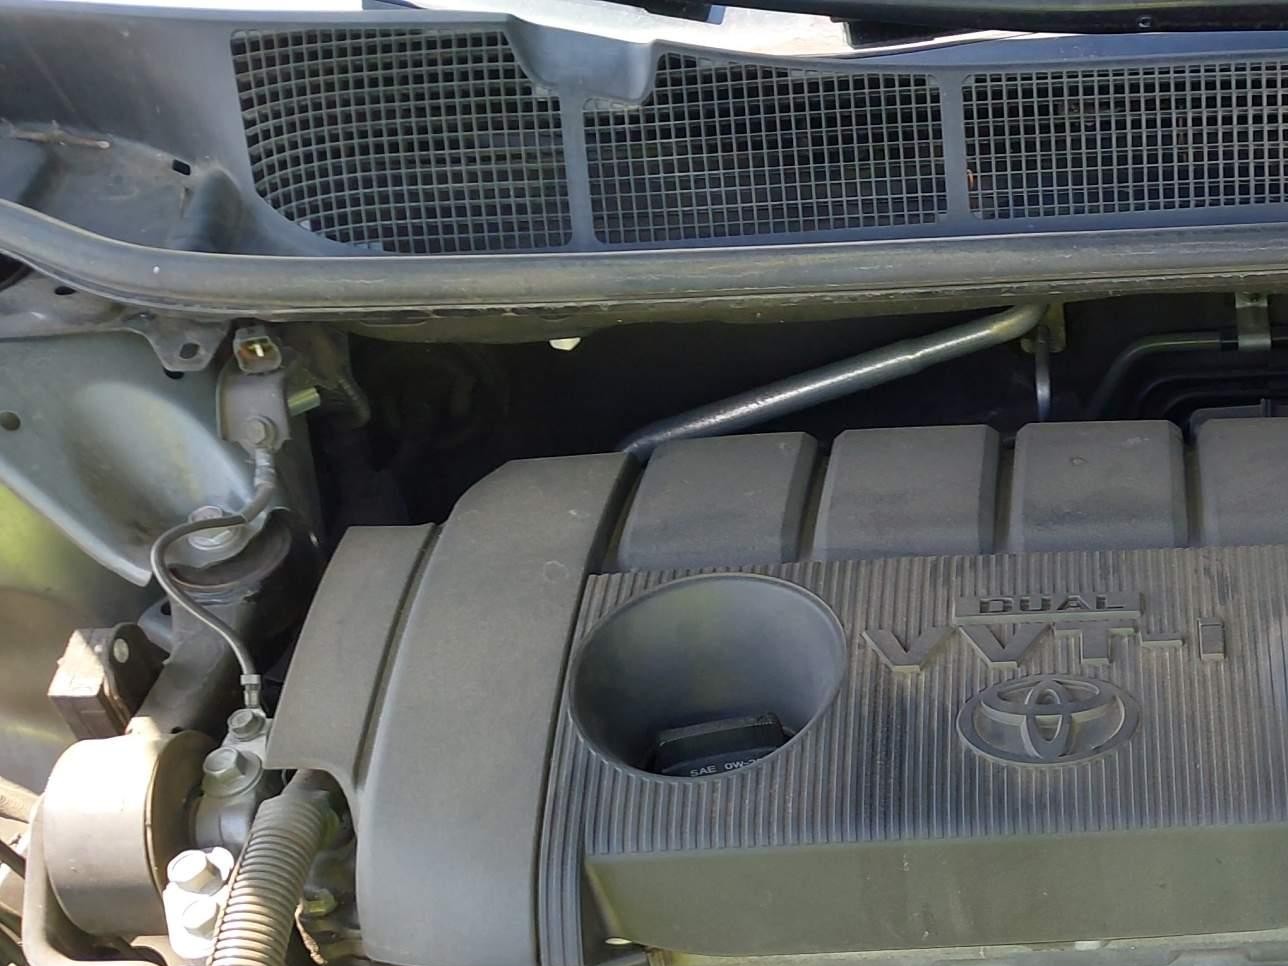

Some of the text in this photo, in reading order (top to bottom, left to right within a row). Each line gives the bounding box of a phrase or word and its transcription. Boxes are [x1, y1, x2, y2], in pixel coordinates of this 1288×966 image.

[978, 594, 1125, 614] DUAL
[690, 759, 762, 777] SAE 0W-2
